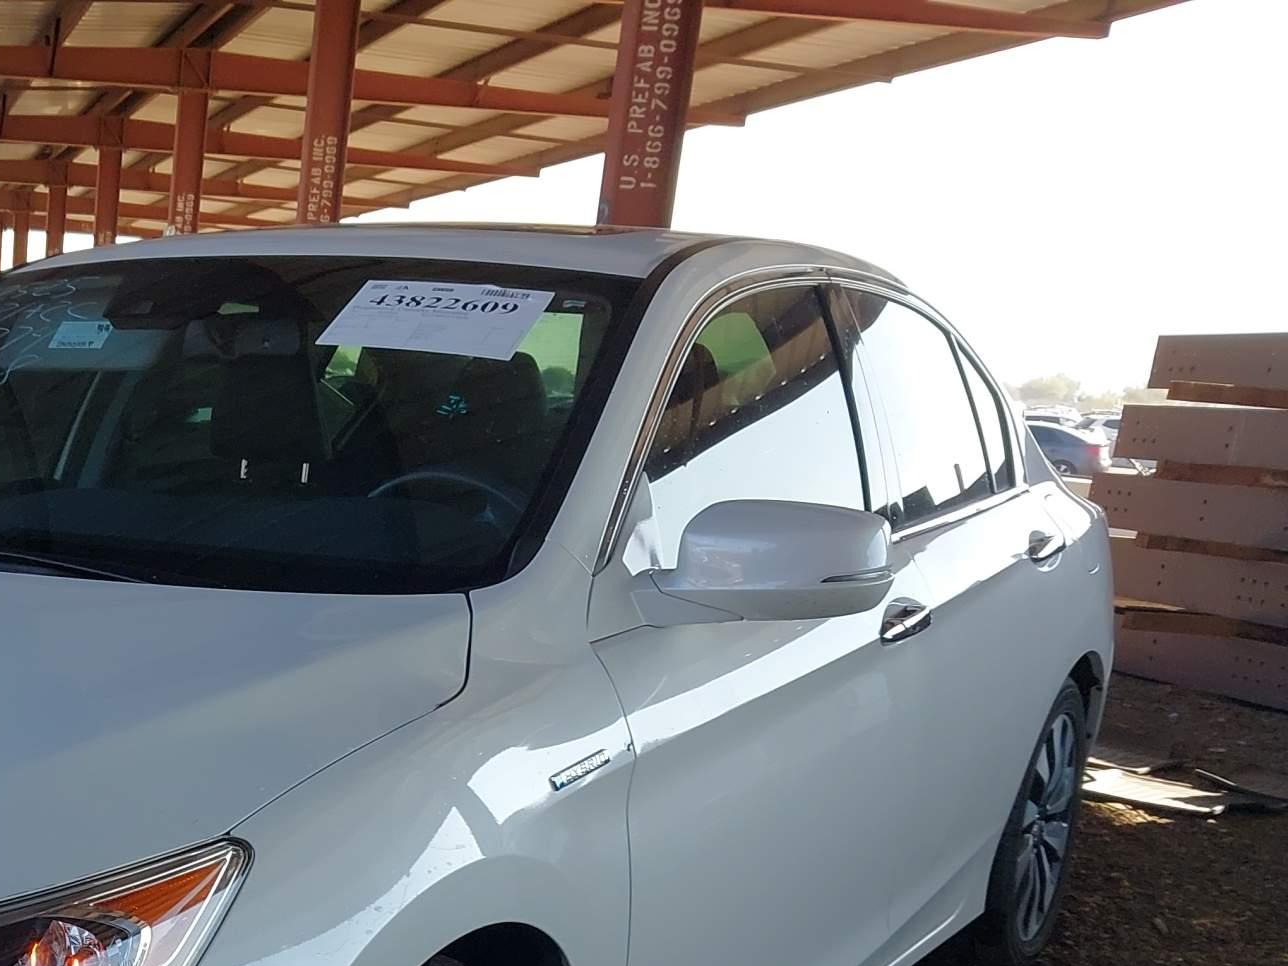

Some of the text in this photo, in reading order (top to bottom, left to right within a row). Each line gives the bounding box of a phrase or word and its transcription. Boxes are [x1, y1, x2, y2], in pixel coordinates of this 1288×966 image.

[627, 44, 655, 134] PREFAB
[307, 167, 322, 220] PREFAB
[369, 293, 520, 315] 43822609
